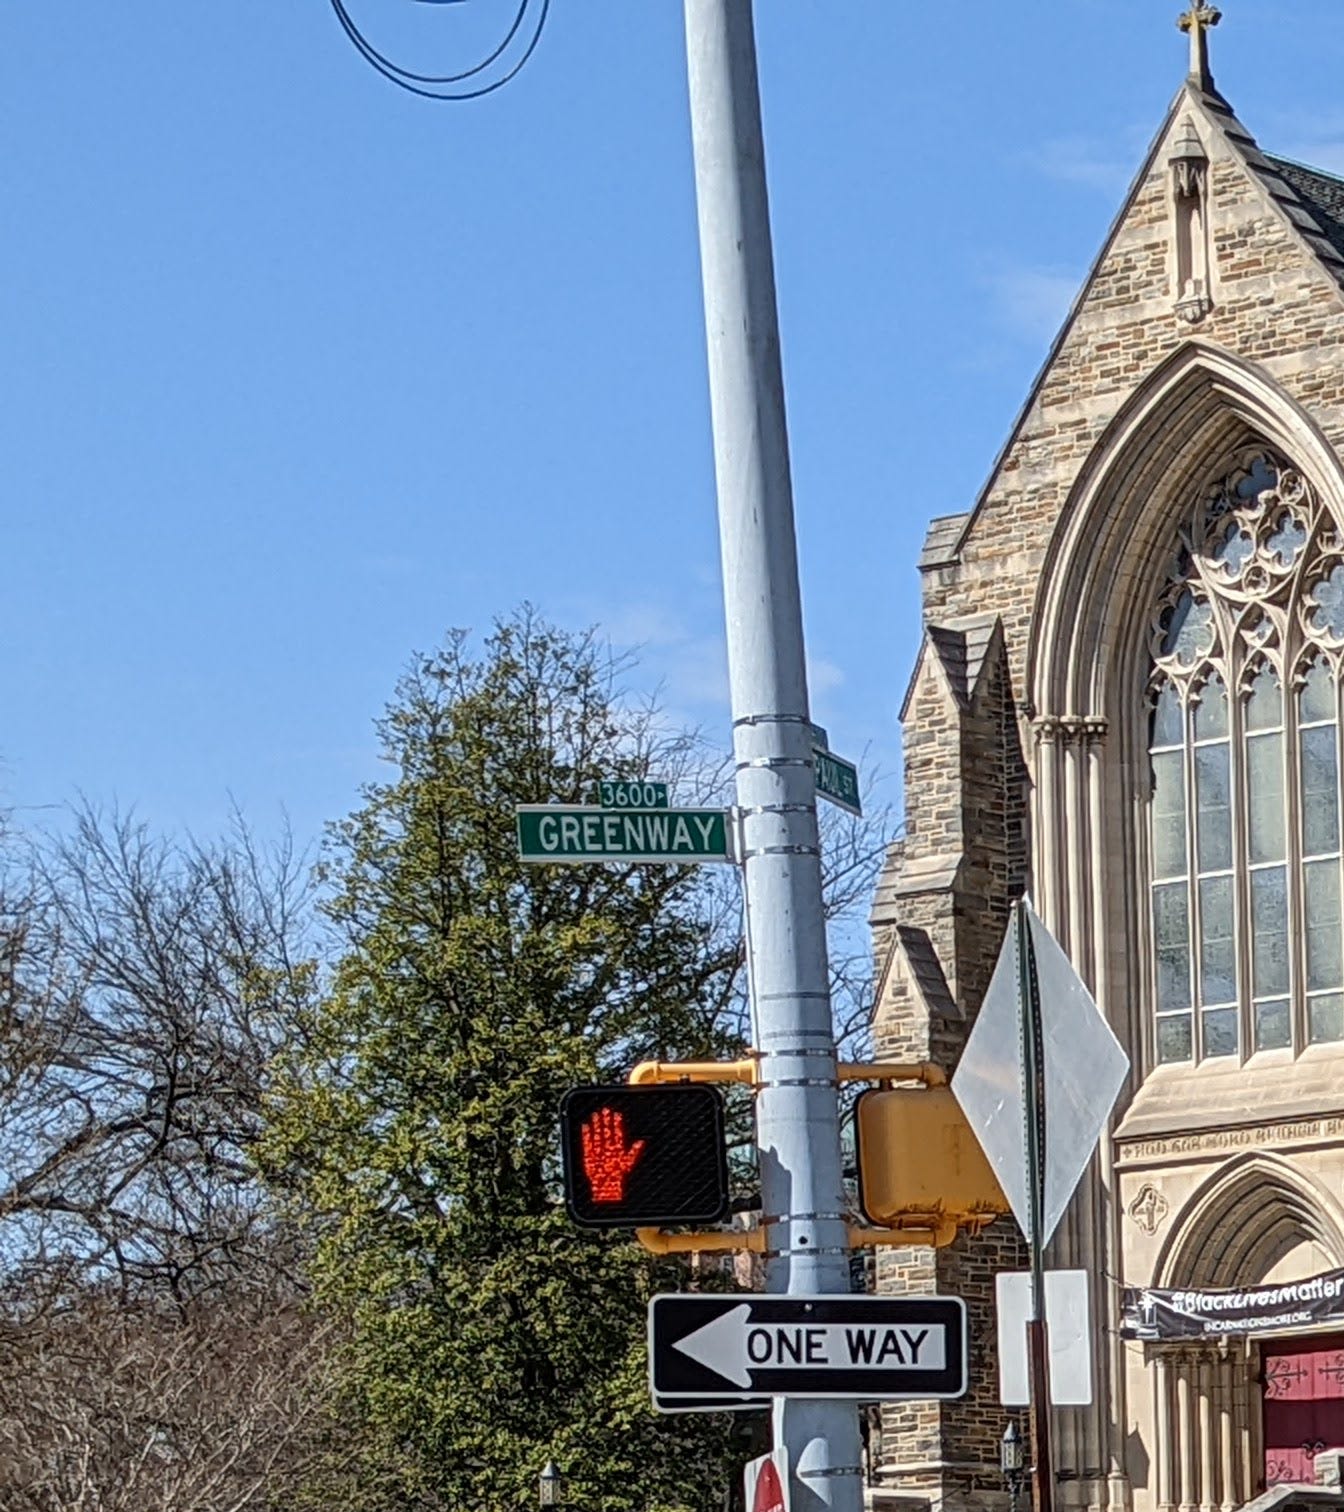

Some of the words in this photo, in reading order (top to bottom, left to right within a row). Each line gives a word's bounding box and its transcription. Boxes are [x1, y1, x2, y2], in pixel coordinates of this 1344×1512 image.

[602, 783, 657, 806] 3600
[538, 815, 715, 851] GREENWAY
[747, 1328, 829, 1365] ONE
[846, 1328, 929, 1365] WAY
